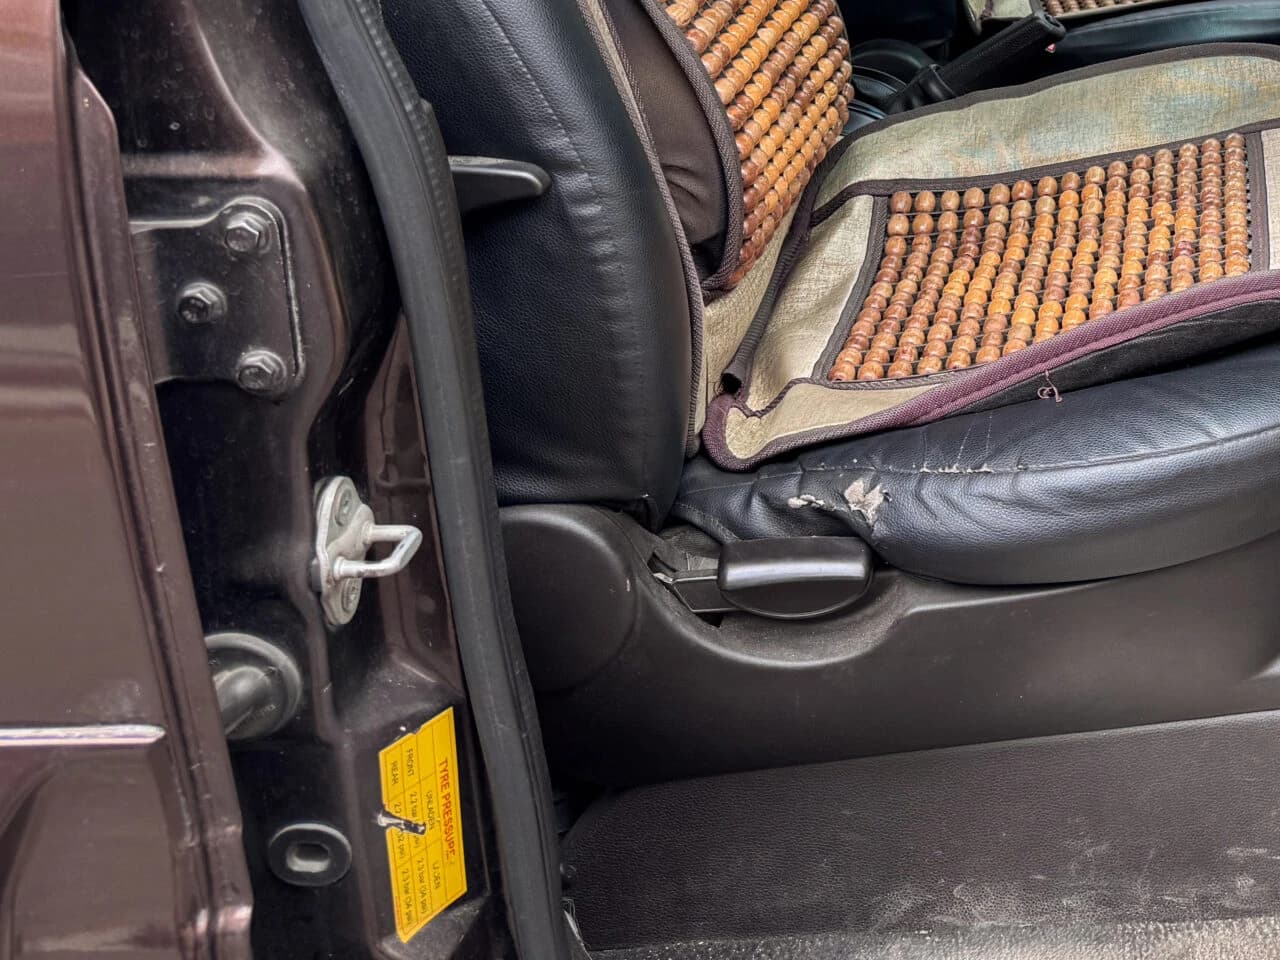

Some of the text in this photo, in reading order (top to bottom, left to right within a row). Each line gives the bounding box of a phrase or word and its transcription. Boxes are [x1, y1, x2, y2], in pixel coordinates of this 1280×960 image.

[391, 760, 400, 785] REAR
[406, 748, 415, 777] FRONT
[439, 757, 450, 792] TYRE
